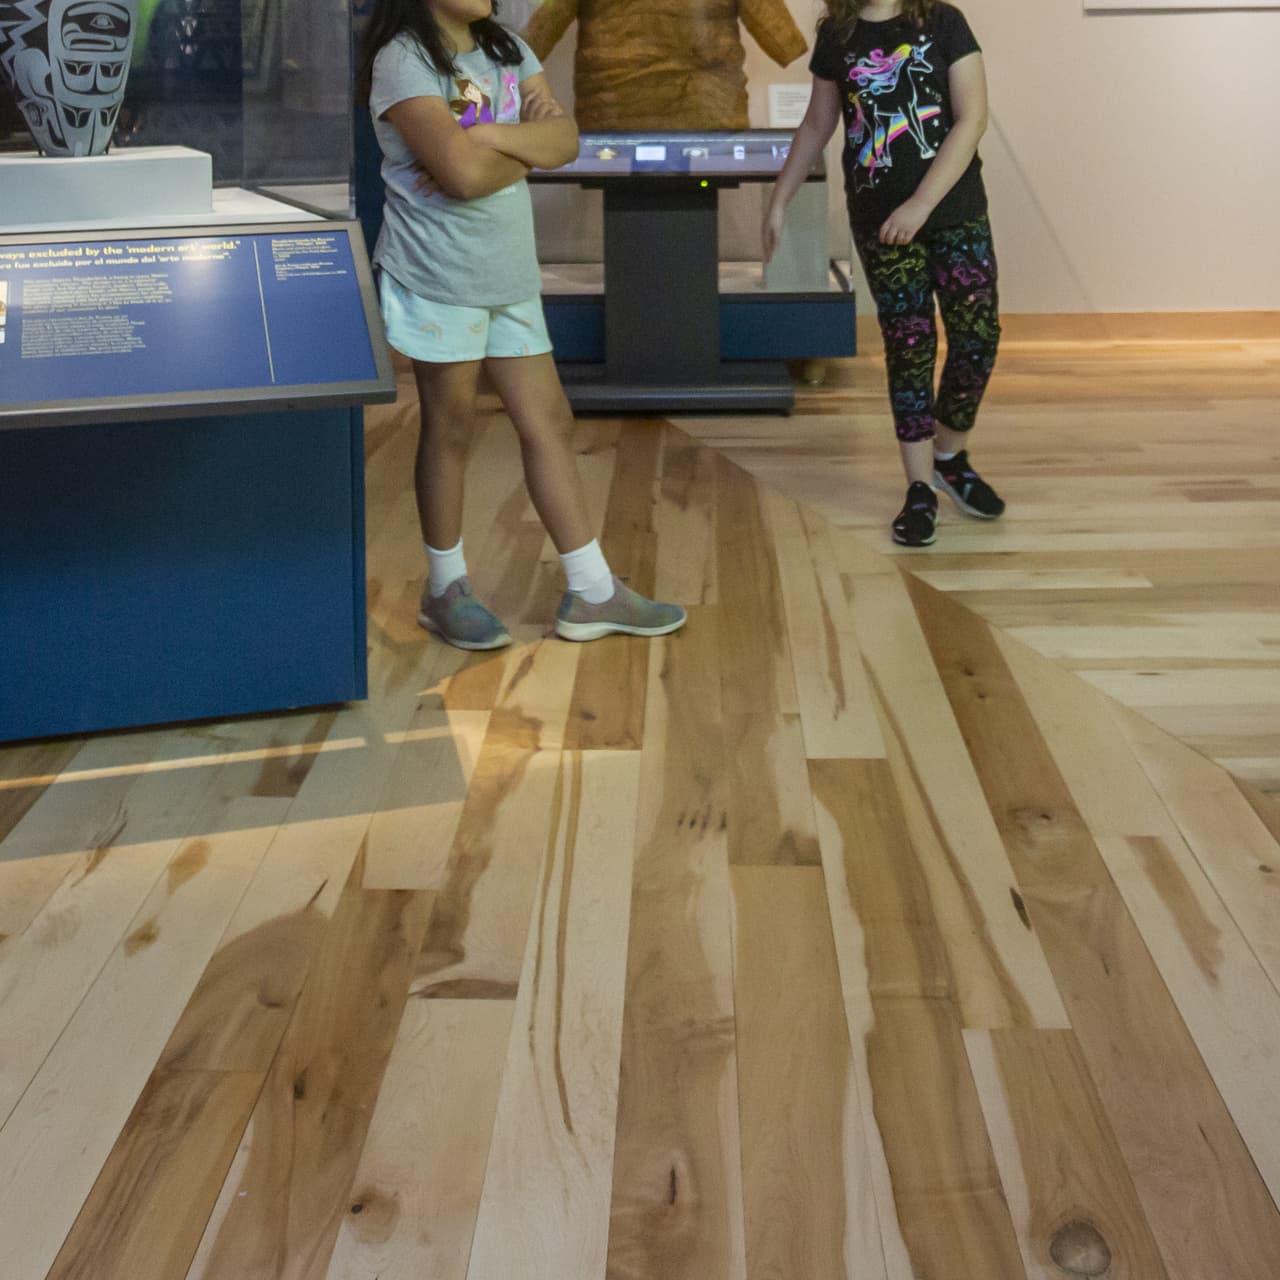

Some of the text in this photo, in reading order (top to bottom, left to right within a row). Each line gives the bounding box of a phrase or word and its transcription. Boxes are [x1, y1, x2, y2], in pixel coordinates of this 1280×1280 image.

[28, 248, 82, 258] excluded
[86, 248, 100, 257] by
[103, 246, 122, 255] the
